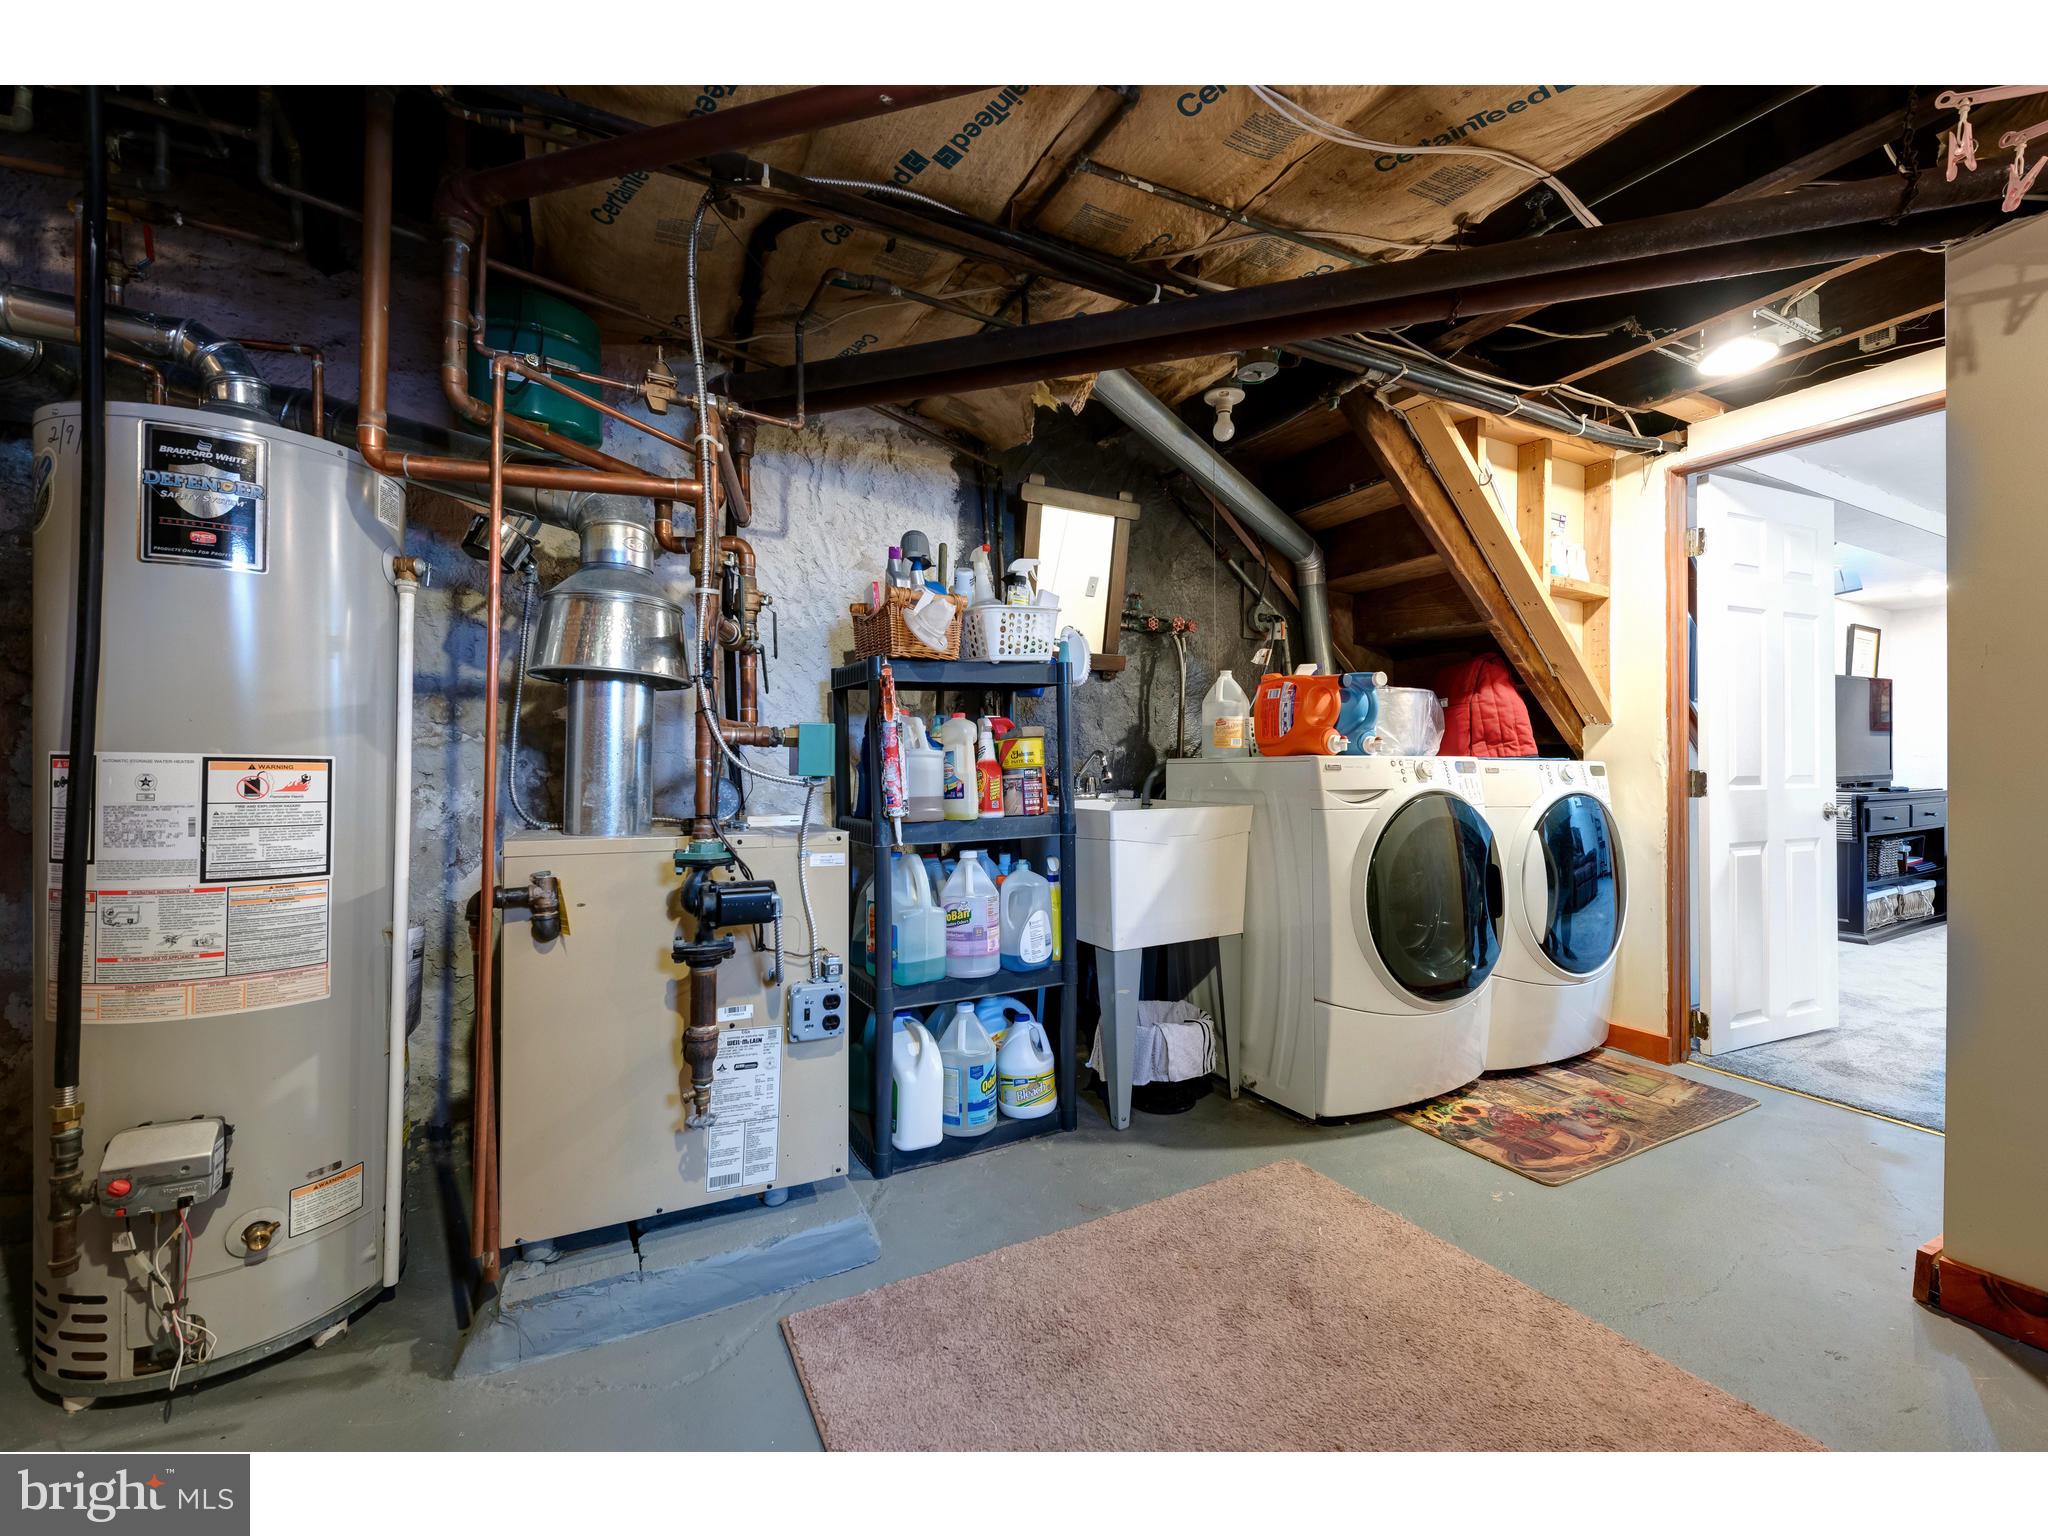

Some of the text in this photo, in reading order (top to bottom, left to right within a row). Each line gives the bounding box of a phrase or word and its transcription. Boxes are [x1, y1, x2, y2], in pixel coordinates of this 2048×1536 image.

[159, 445, 248, 465] BRADFORD WHITE
[143, 467, 266, 500] DEFENDER
[160, 489, 199, 501] SAFETY
